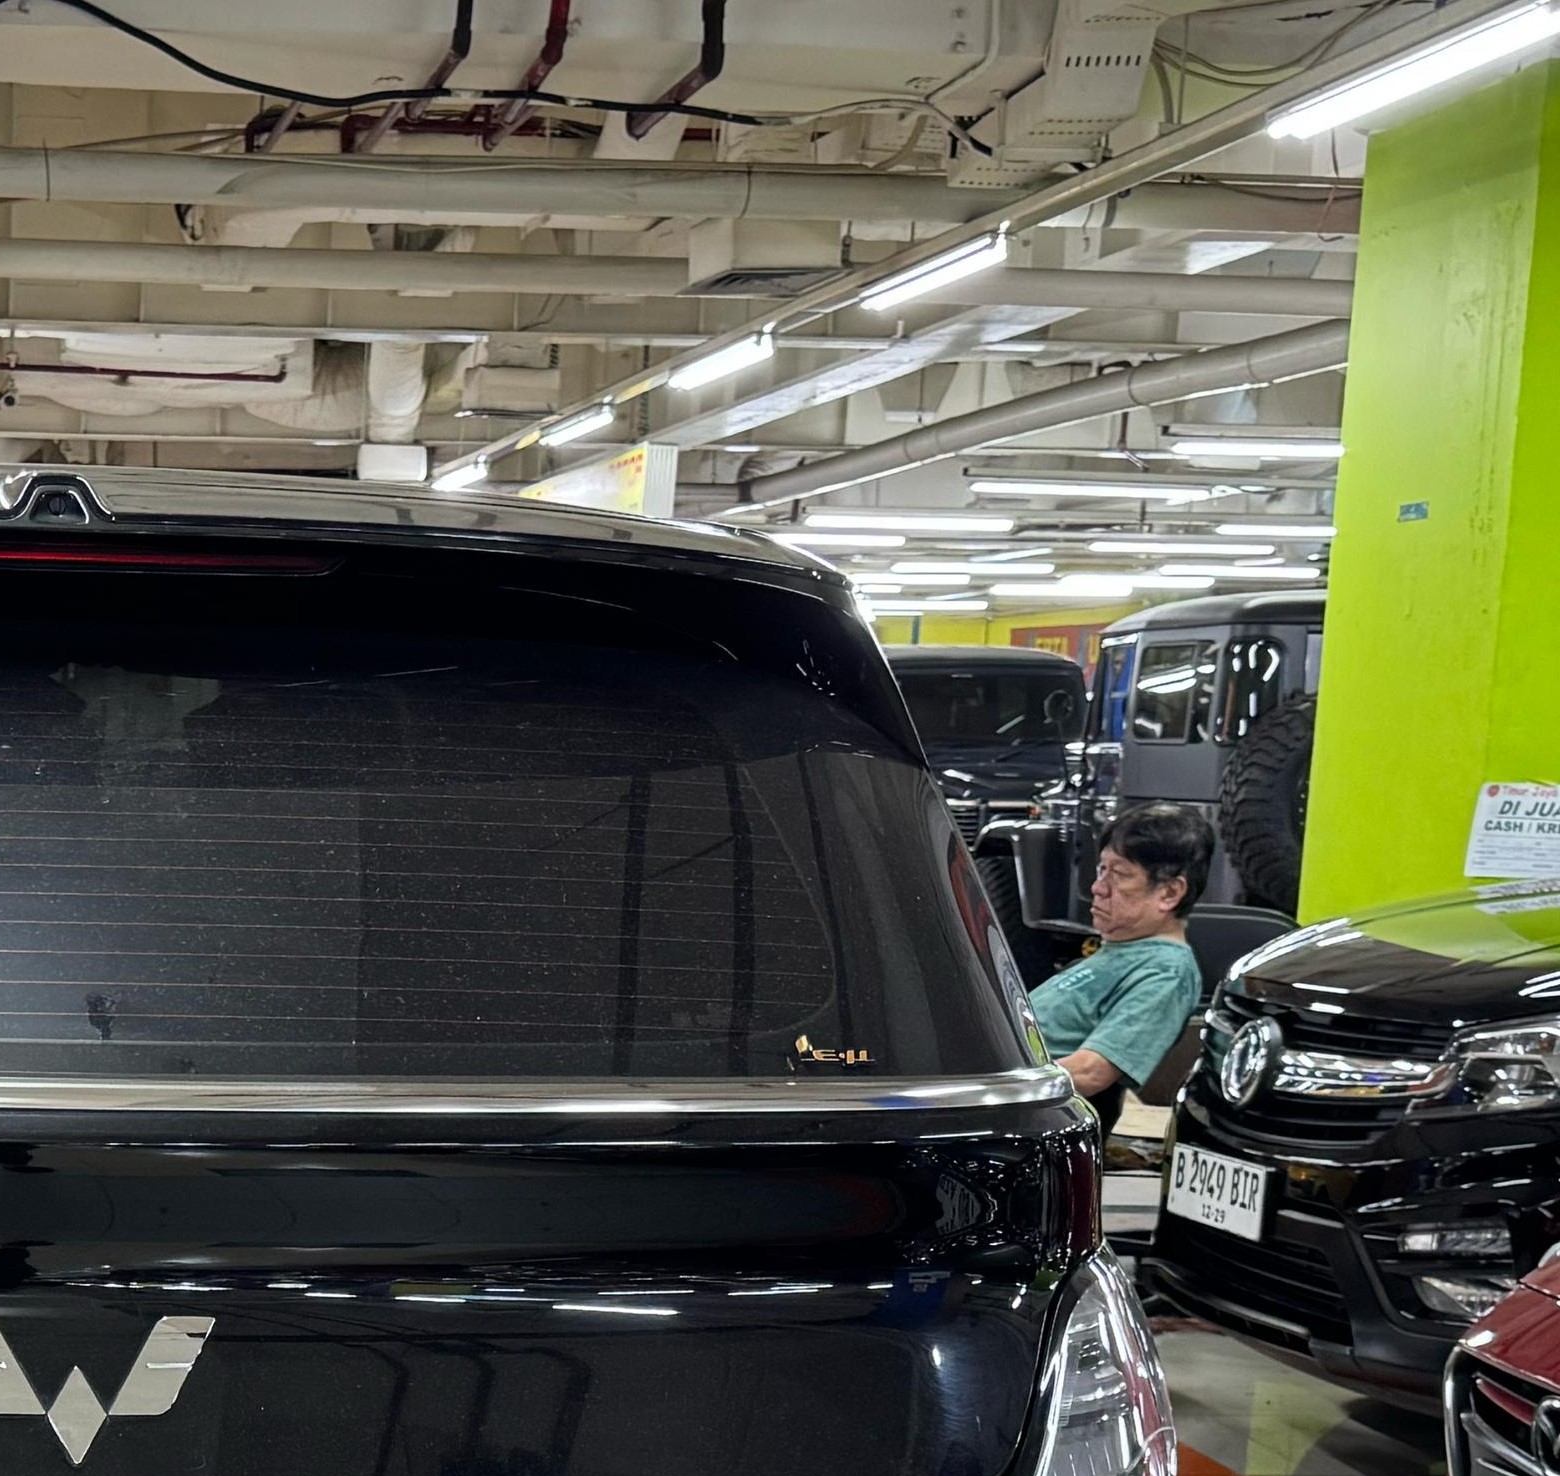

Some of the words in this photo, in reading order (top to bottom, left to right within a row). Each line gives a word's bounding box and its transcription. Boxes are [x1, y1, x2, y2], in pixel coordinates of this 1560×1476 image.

[1499, 800, 1521, 816] DI
[1484, 820, 1524, 833] CASH
[1175, 1151, 1186, 1190] B
[1189, 1150, 1226, 1203] 2949
[1230, 1166, 1260, 1214] BIR
